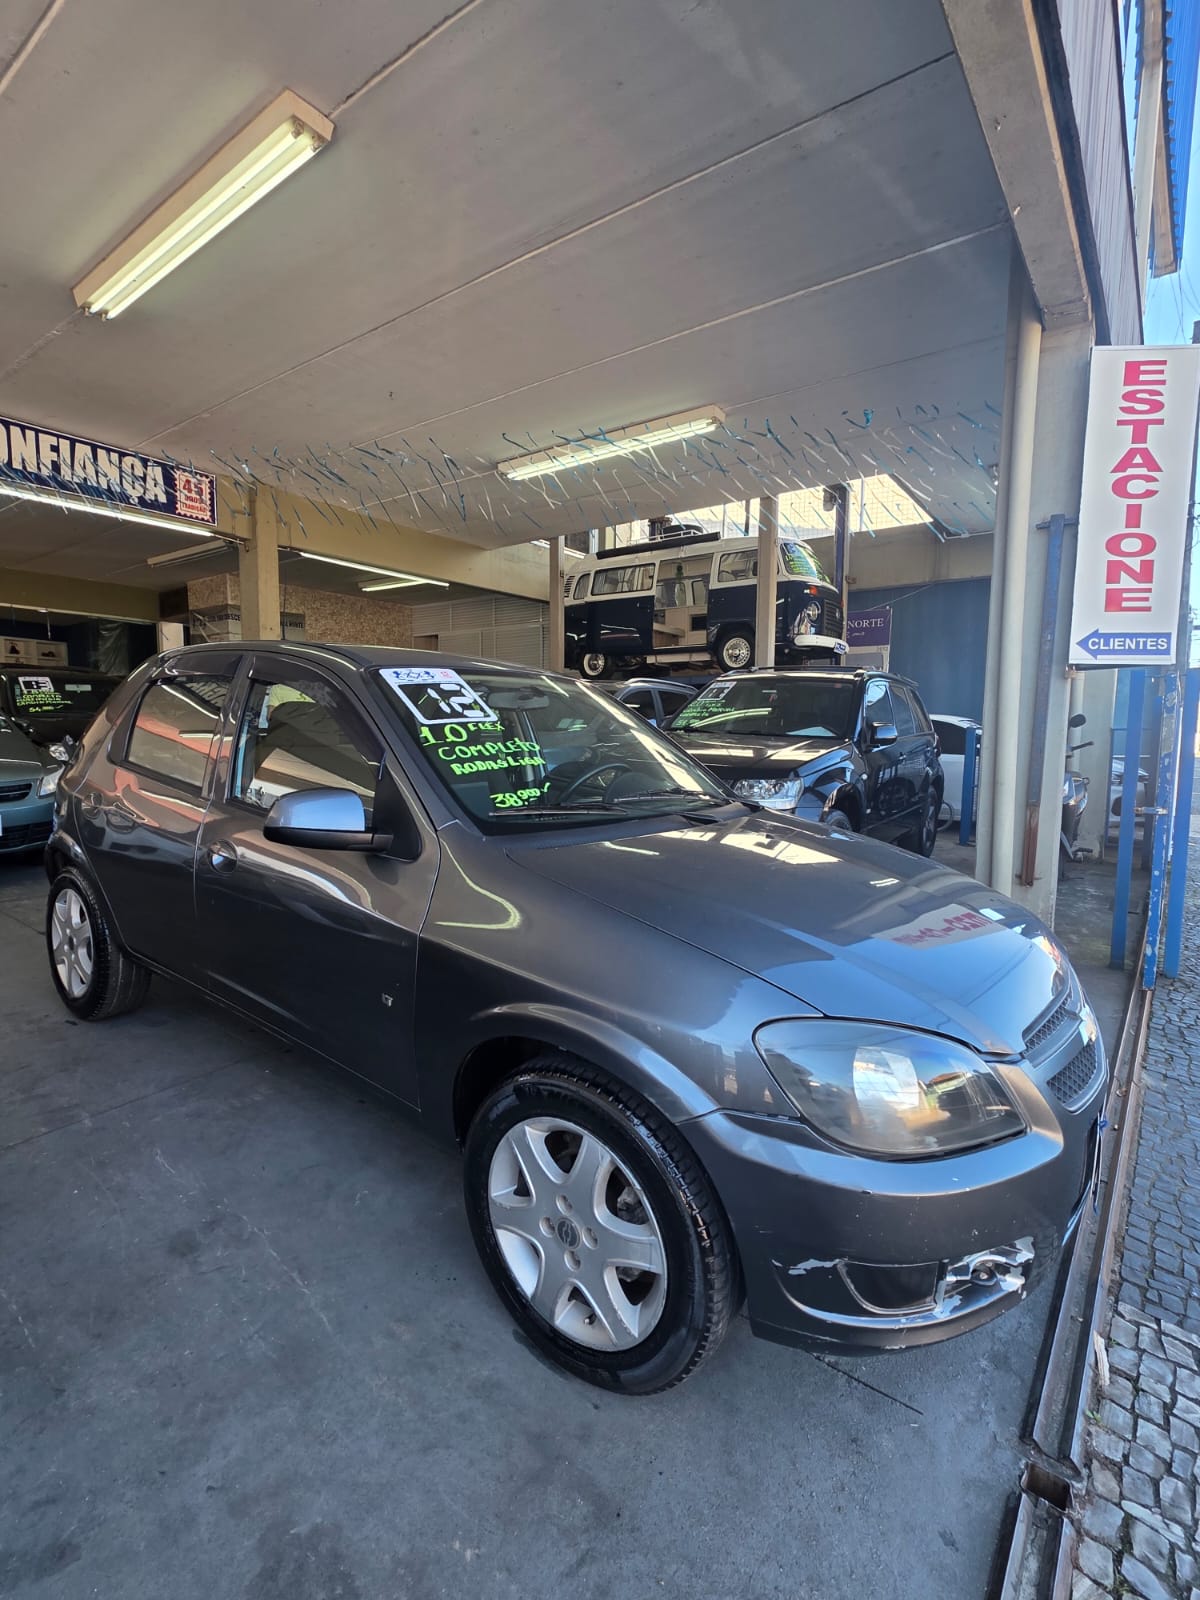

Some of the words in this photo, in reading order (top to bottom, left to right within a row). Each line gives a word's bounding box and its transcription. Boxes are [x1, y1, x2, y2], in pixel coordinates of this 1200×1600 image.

[1103, 359, 1167, 613] ESTACIONE
[847, 617, 885, 629] NORTE
[1087, 636, 1168, 650] CLIENTES
[427, 683, 484, 718] 12
[467, 721, 505, 732] FLEX
[450, 759, 508, 775] RODAS
